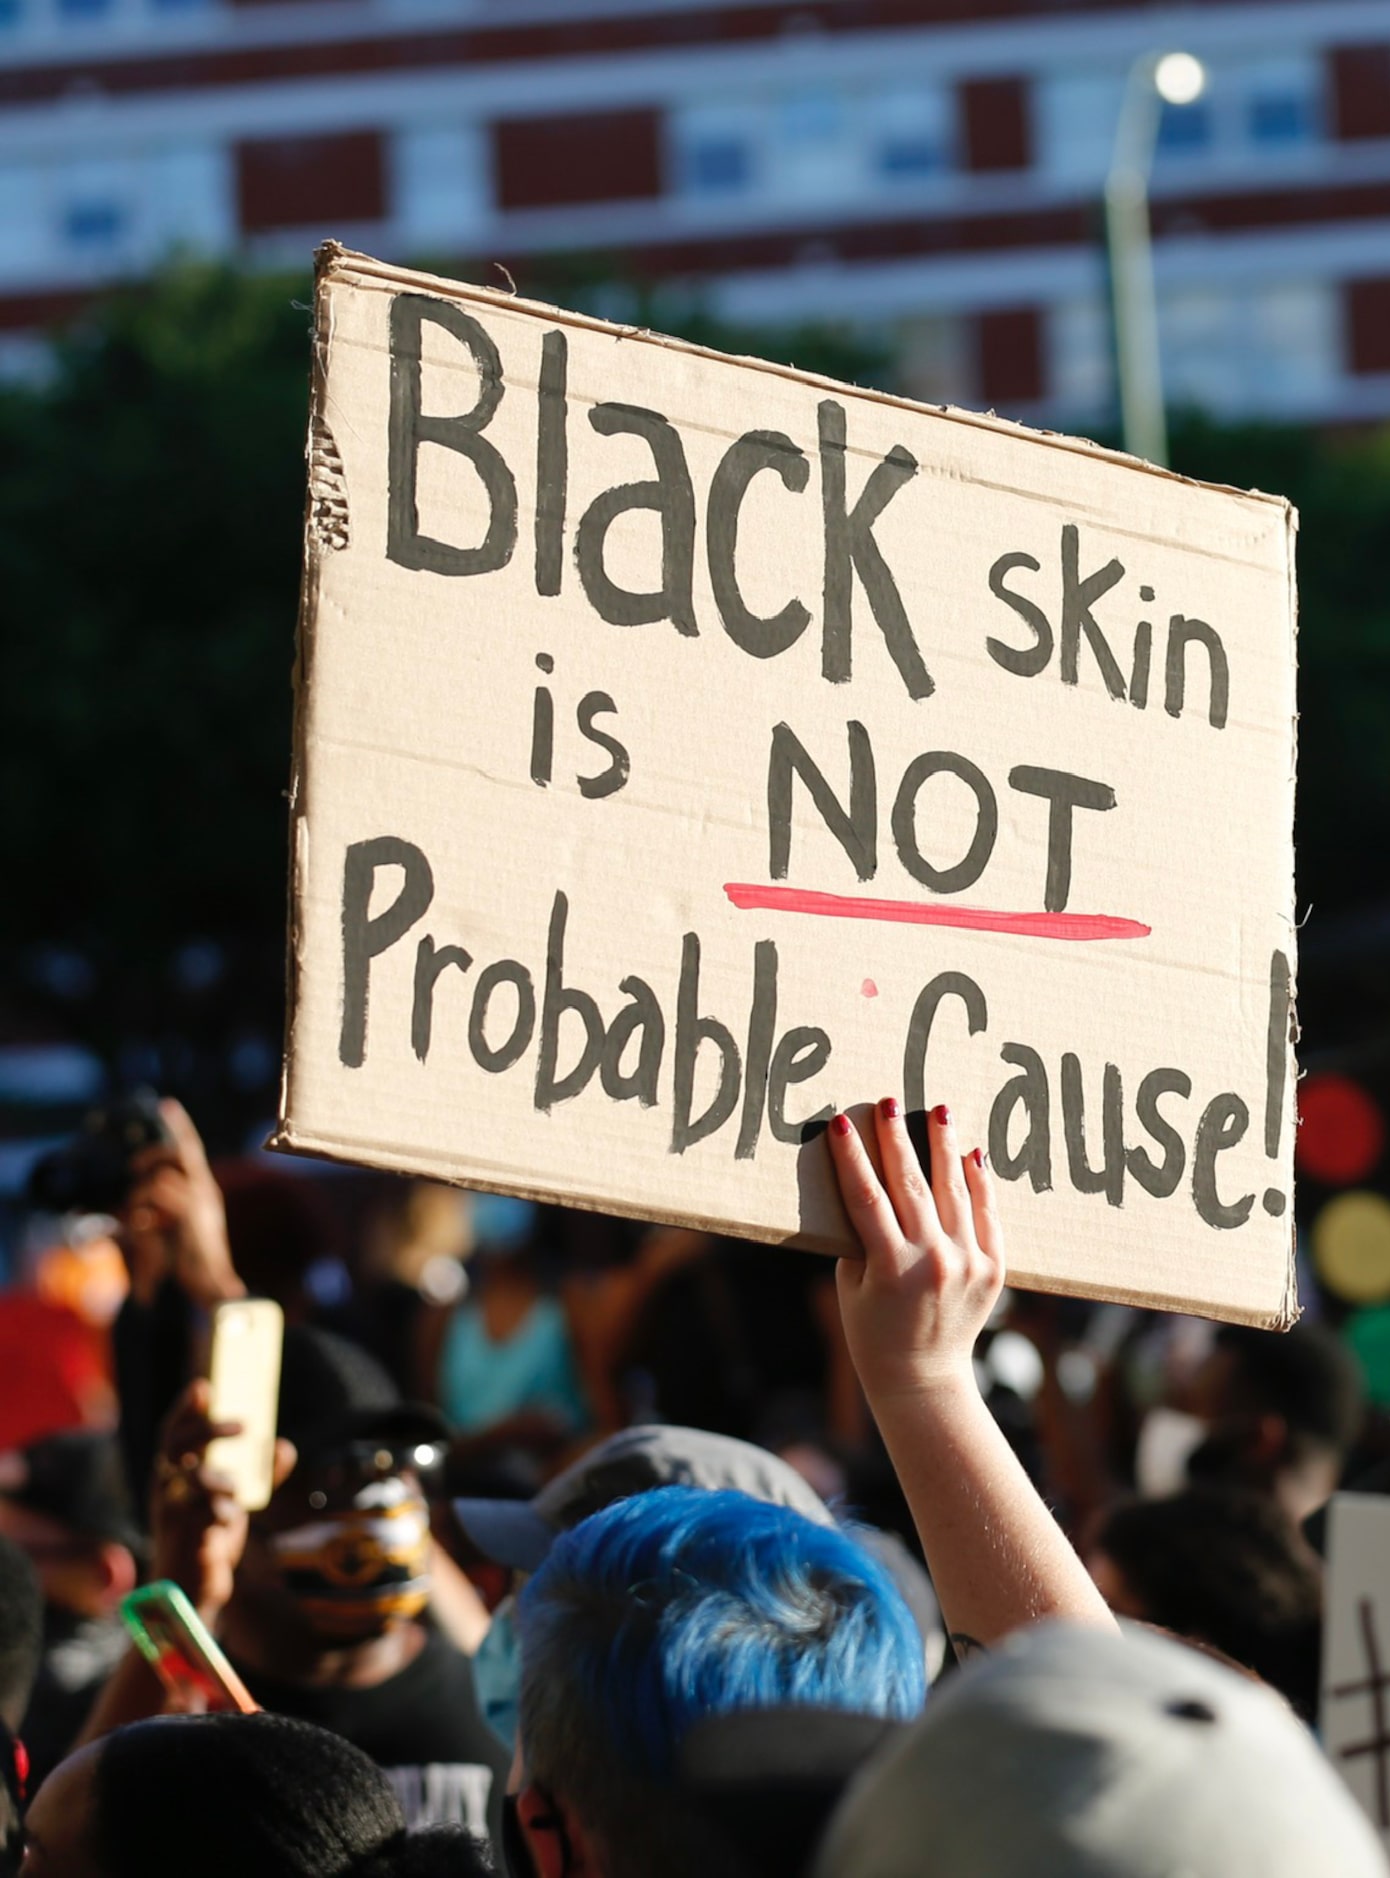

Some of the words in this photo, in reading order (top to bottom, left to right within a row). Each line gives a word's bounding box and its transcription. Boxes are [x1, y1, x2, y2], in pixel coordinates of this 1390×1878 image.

[387, 292, 936, 701] Black
[986, 524, 1230, 730] skin
[529, 652, 631, 800] is
[768, 719, 1118, 913] NOT
[339, 835, 837, 1160] Probable
[904, 948, 1288, 1230] Cause!
